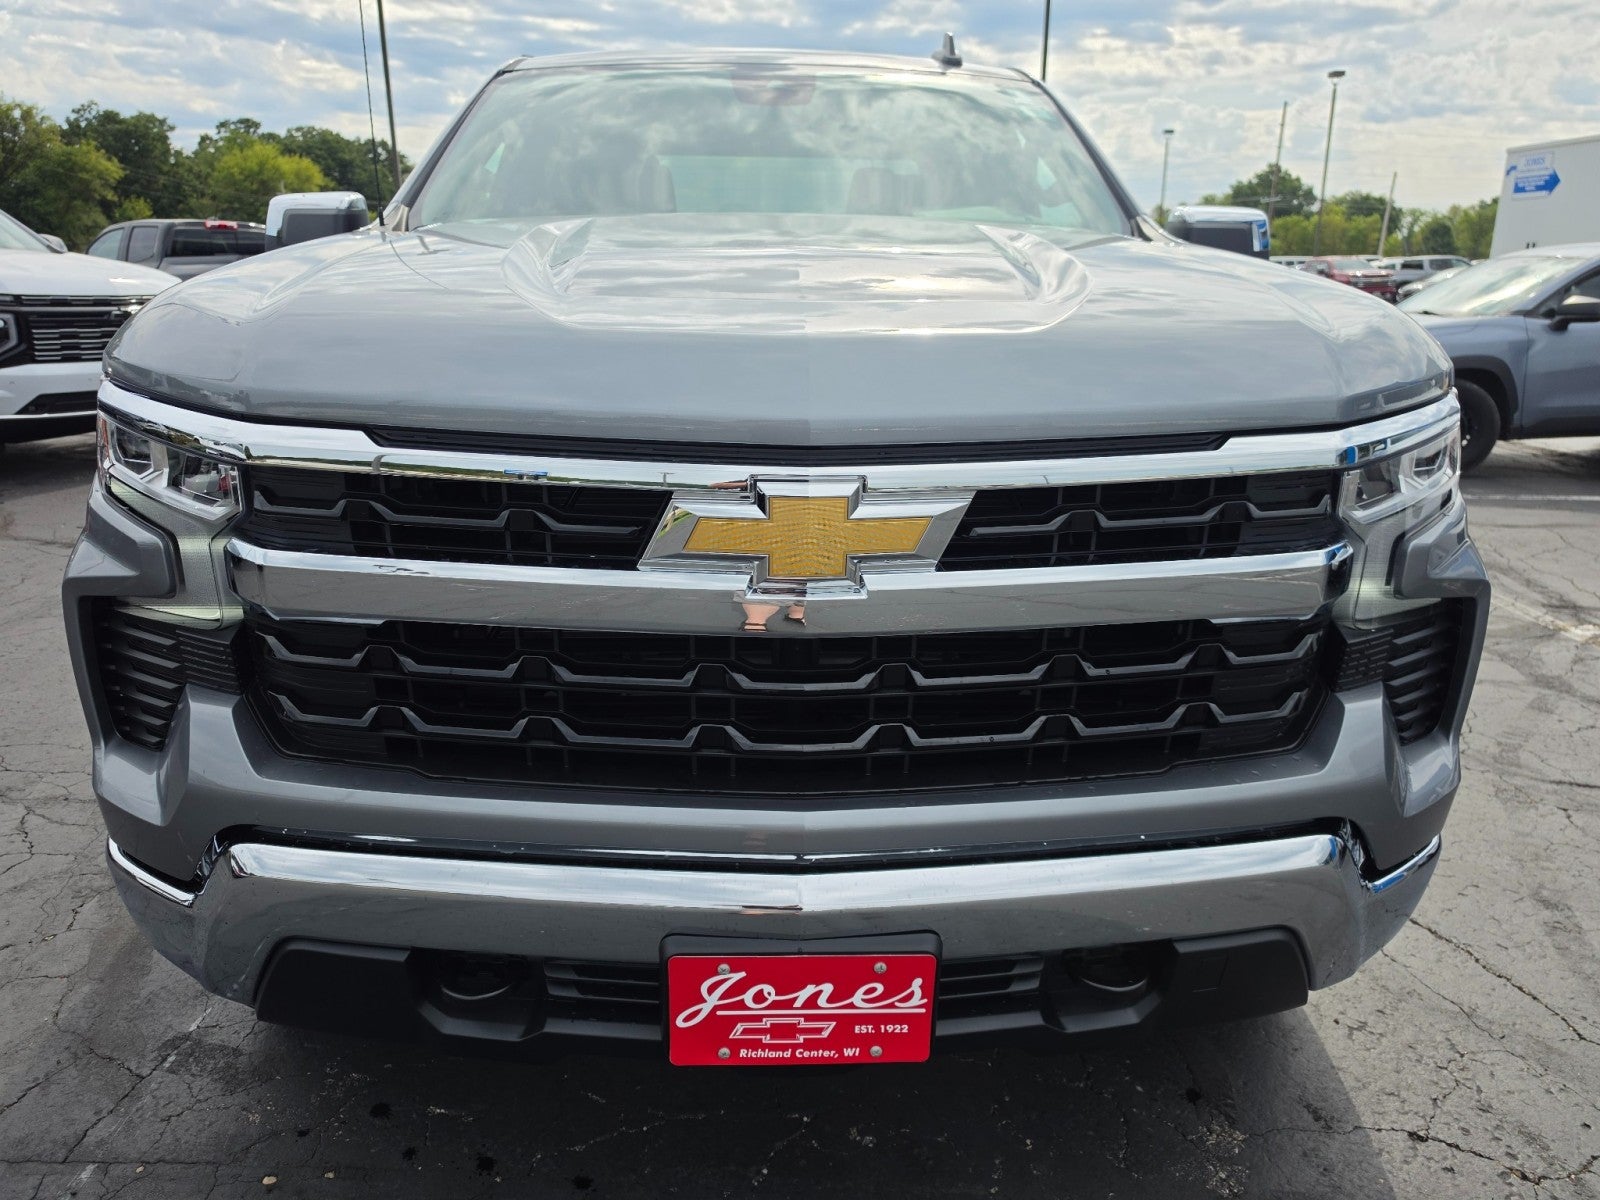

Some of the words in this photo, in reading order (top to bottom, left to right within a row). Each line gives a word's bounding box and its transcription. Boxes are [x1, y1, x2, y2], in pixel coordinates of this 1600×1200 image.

[675, 971, 928, 1028] Jones
[854, 1025, 876, 1034] EST.
[880, 1024, 909, 1034] 1922
[739, 1048, 791, 1059] Richland
[795, 1048, 839, 1059] Center,
[843, 1047, 860, 1057] WI
